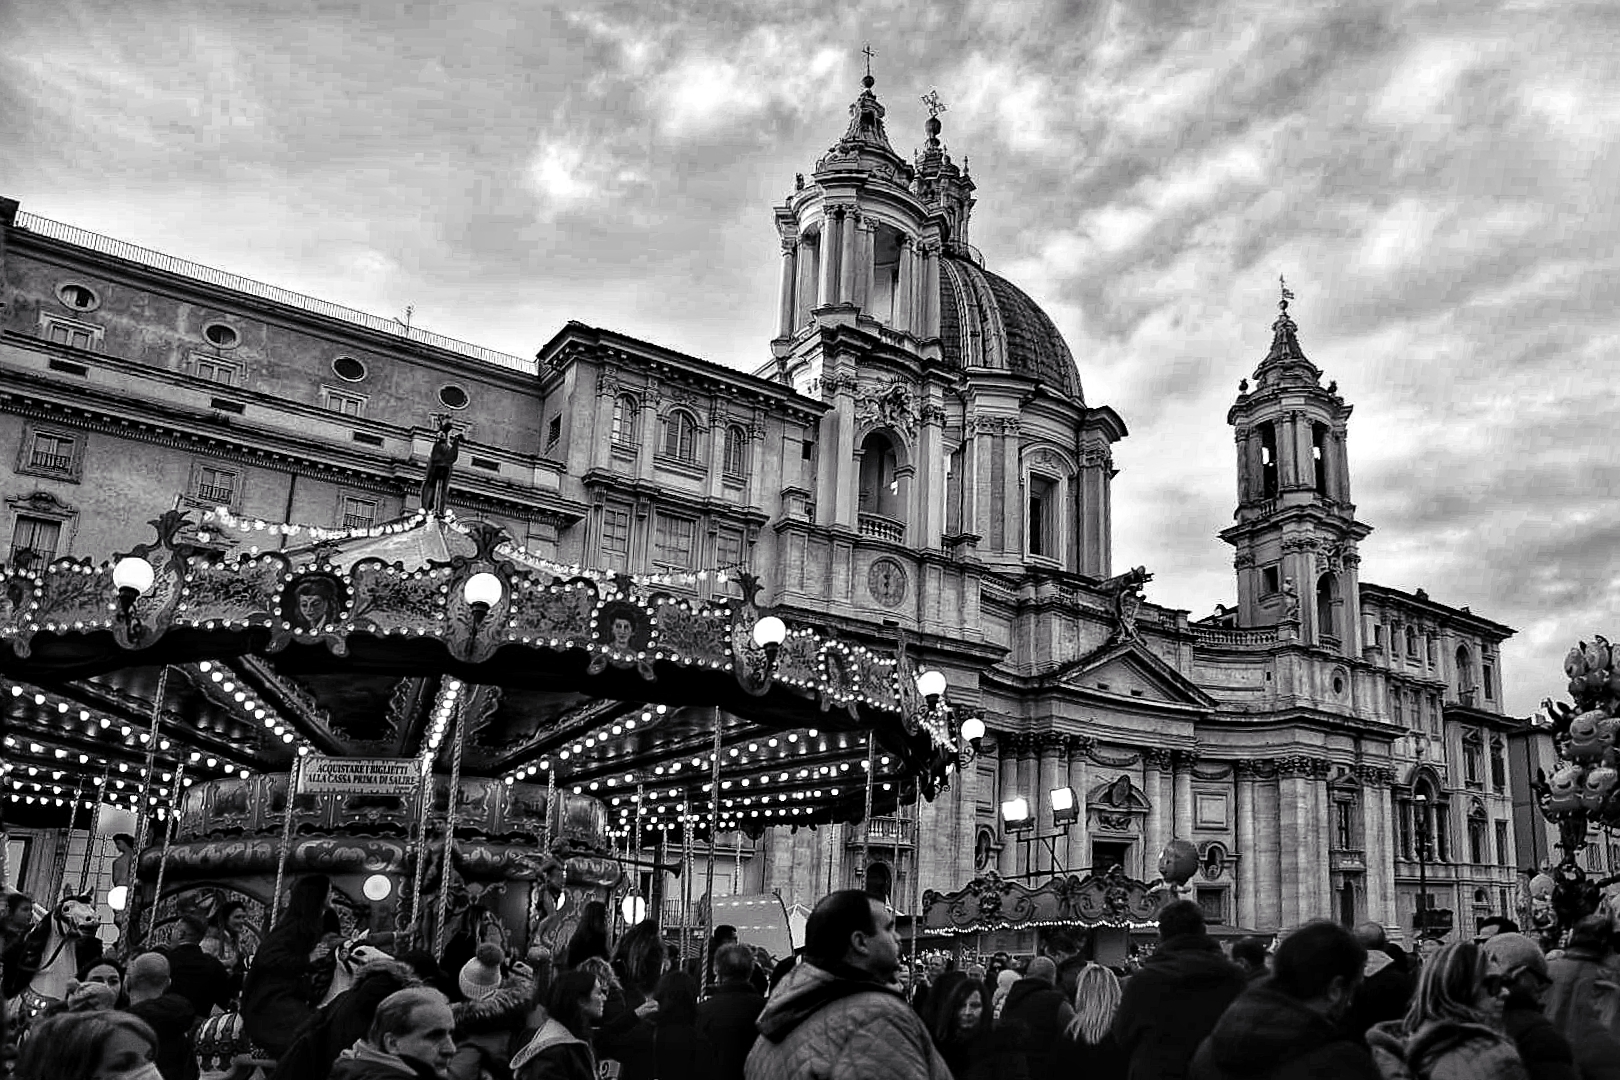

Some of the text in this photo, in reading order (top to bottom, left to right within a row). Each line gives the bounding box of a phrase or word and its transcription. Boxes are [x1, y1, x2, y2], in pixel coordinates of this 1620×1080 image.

[317, 764, 364, 776] ACQUISTARE
[369, 765, 408, 775] BIGLIETTI
[308, 774, 415, 785] ALLA CASSA PRIMA DI SALIRE
